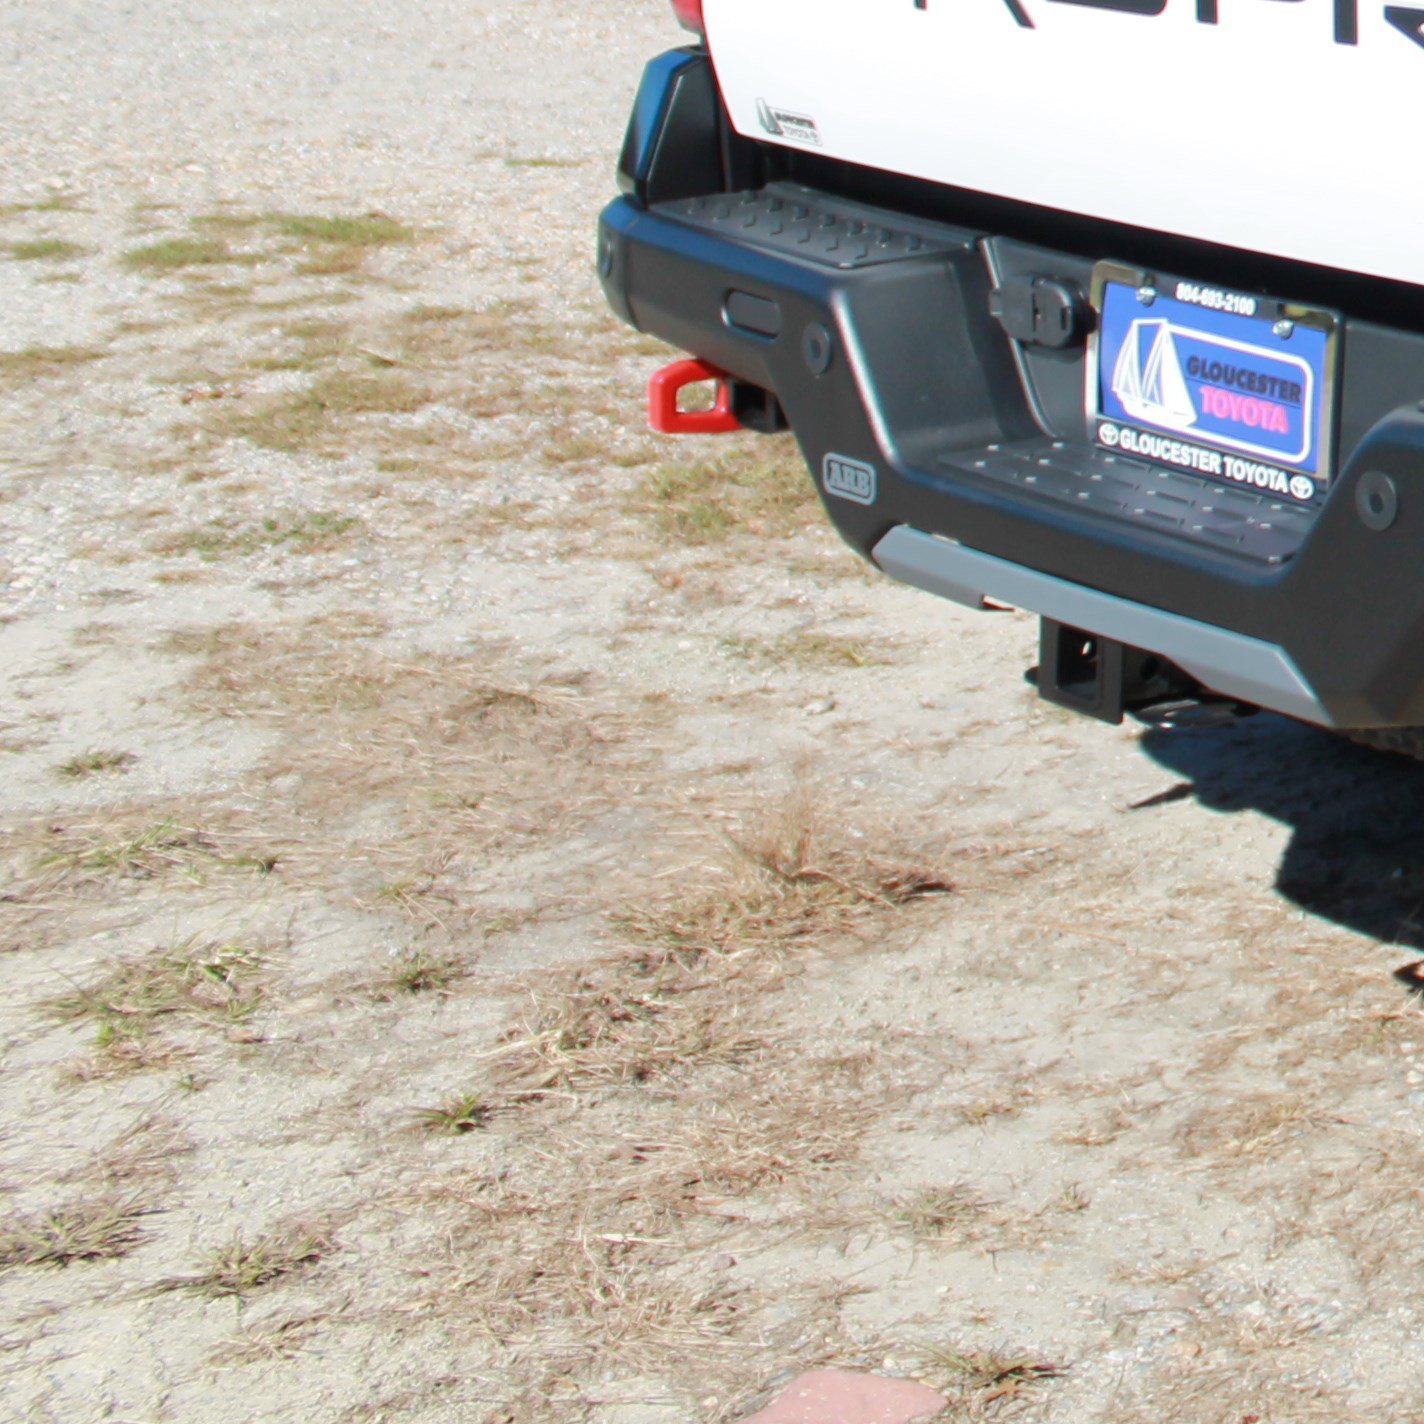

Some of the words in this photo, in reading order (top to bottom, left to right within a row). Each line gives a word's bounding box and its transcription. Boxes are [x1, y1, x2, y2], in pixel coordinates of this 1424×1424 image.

[1187, 356, 1301, 401] GLOUCESTER
[1200, 385, 1288, 434] TOYOTA
[829, 461, 870, 497] ARB
[1120, 429, 1222, 474] GLOUCESTER
[1223, 456, 1288, 493] TOYOTA
